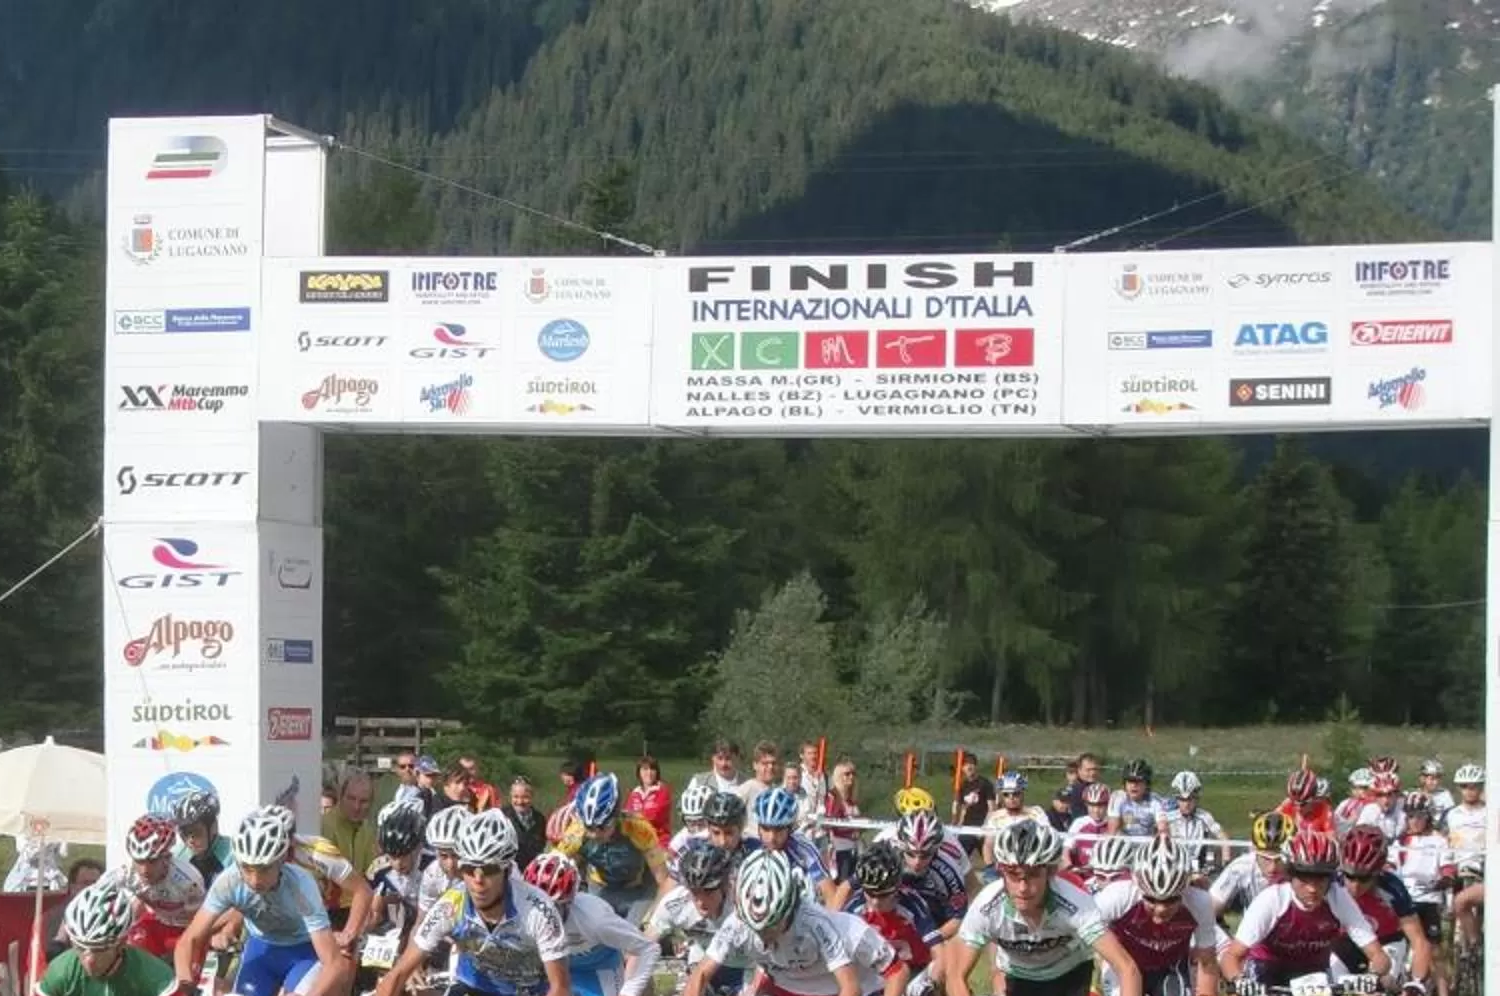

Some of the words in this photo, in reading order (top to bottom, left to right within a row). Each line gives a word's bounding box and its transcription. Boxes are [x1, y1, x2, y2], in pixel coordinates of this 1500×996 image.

[168, 227, 221, 241] COMUNE
[168, 244, 248, 257] LUGAGNANO
[688, 261, 1034, 293] FINISH
[1355, 260, 1451, 282] INFOTRE
[411, 271, 497, 291] INFOTRE
[1255, 272, 1332, 288] syncros
[692, 297, 912, 322] INTERNAZIONALI
[925, 295, 1034, 319] D'ITALIA
[1234, 321, 1328, 346] ATAG
[1382, 322, 1450, 342] ENERVIT
[316, 335, 389, 347] SCOTT
[409, 347, 497, 359] GIST
[686, 375, 763, 387] MASSA
[875, 373, 987, 386] SIRMIONE
[995, 372, 1040, 386] (BS)
[172, 384, 248, 397] Maremma
[302, 373, 379, 410] Alpago
[686, 390, 771, 402] NALLES
[779, 389, 823, 403] (BZ)
[843, 388, 985, 401] LUGAGNANO
[993, 387, 1038, 401] (PC)
[1255, 384, 1325, 400] SENINI
[686, 406, 773, 418] ALPAGO
[780, 405, 824, 419] (BL)
[857, 403, 983, 417] VERMIGLIO
[991, 402, 1037, 417] (TN)
[141, 471, 250, 487] SCOTT
[118, 571, 243, 589] GIST
[123, 612, 234, 666] Alpago
